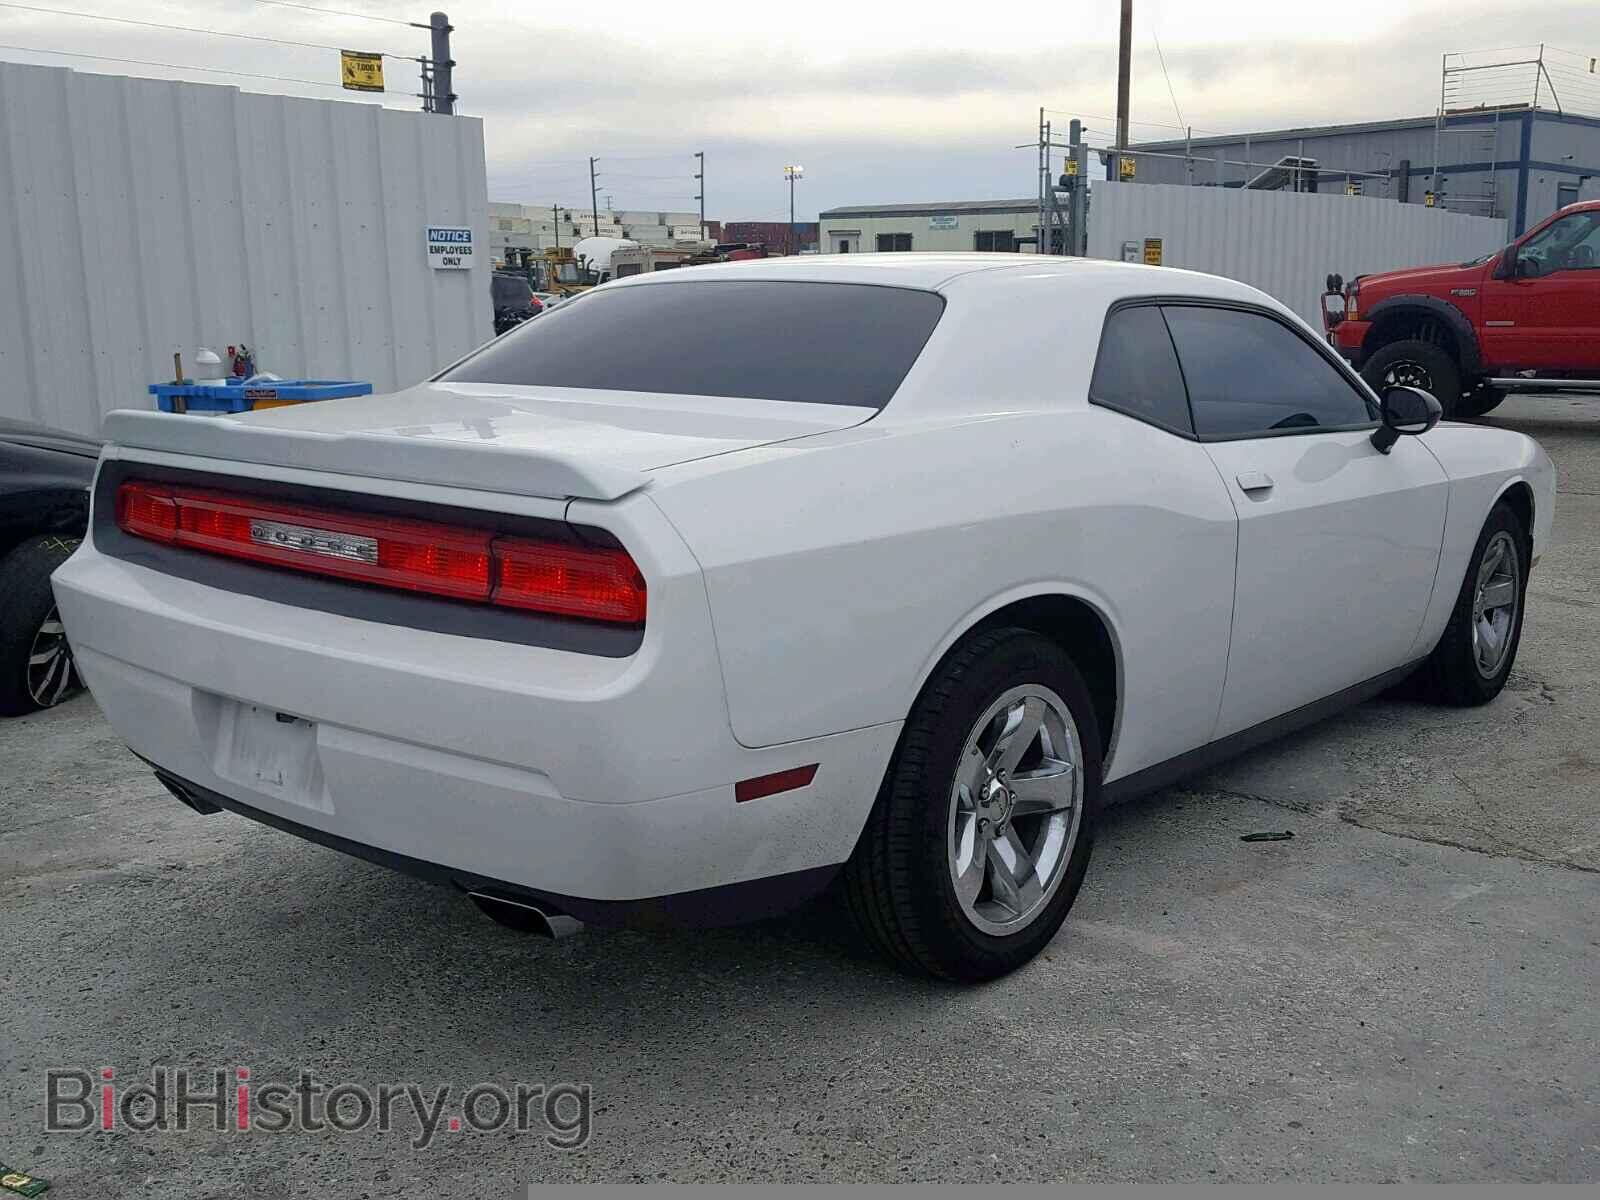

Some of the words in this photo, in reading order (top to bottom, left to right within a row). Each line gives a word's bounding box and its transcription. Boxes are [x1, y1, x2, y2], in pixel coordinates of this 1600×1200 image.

[430, 230, 470, 241] NOTICE
[429, 245, 472, 255] EMPLOYEES
[442, 257, 461, 265] ONLY
